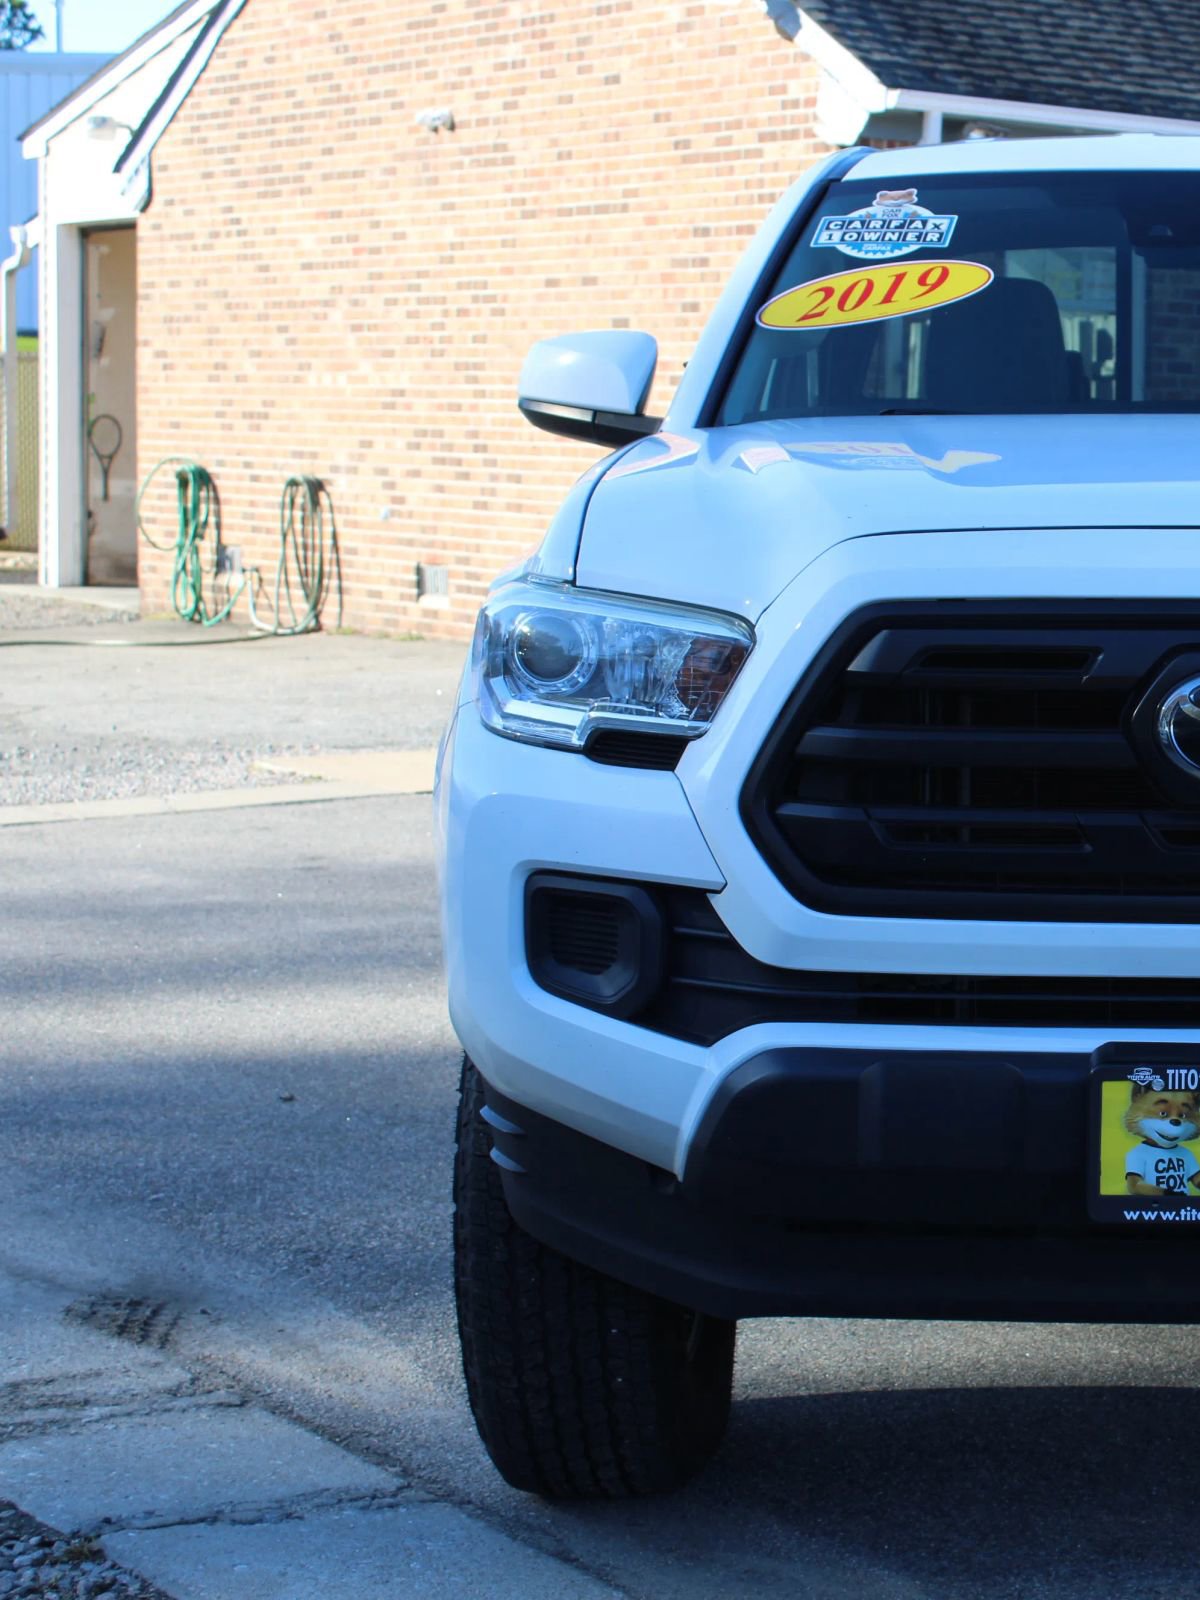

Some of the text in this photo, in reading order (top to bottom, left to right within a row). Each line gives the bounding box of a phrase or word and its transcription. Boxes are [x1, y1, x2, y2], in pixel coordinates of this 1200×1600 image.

[828, 219, 945, 231] CARFAX
[825, 232, 940, 242] 1 OWNER
[796, 265, 950, 322] 2019
[1154, 1157, 1185, 1174] CAR
[1155, 1174, 1187, 1191] FOX
